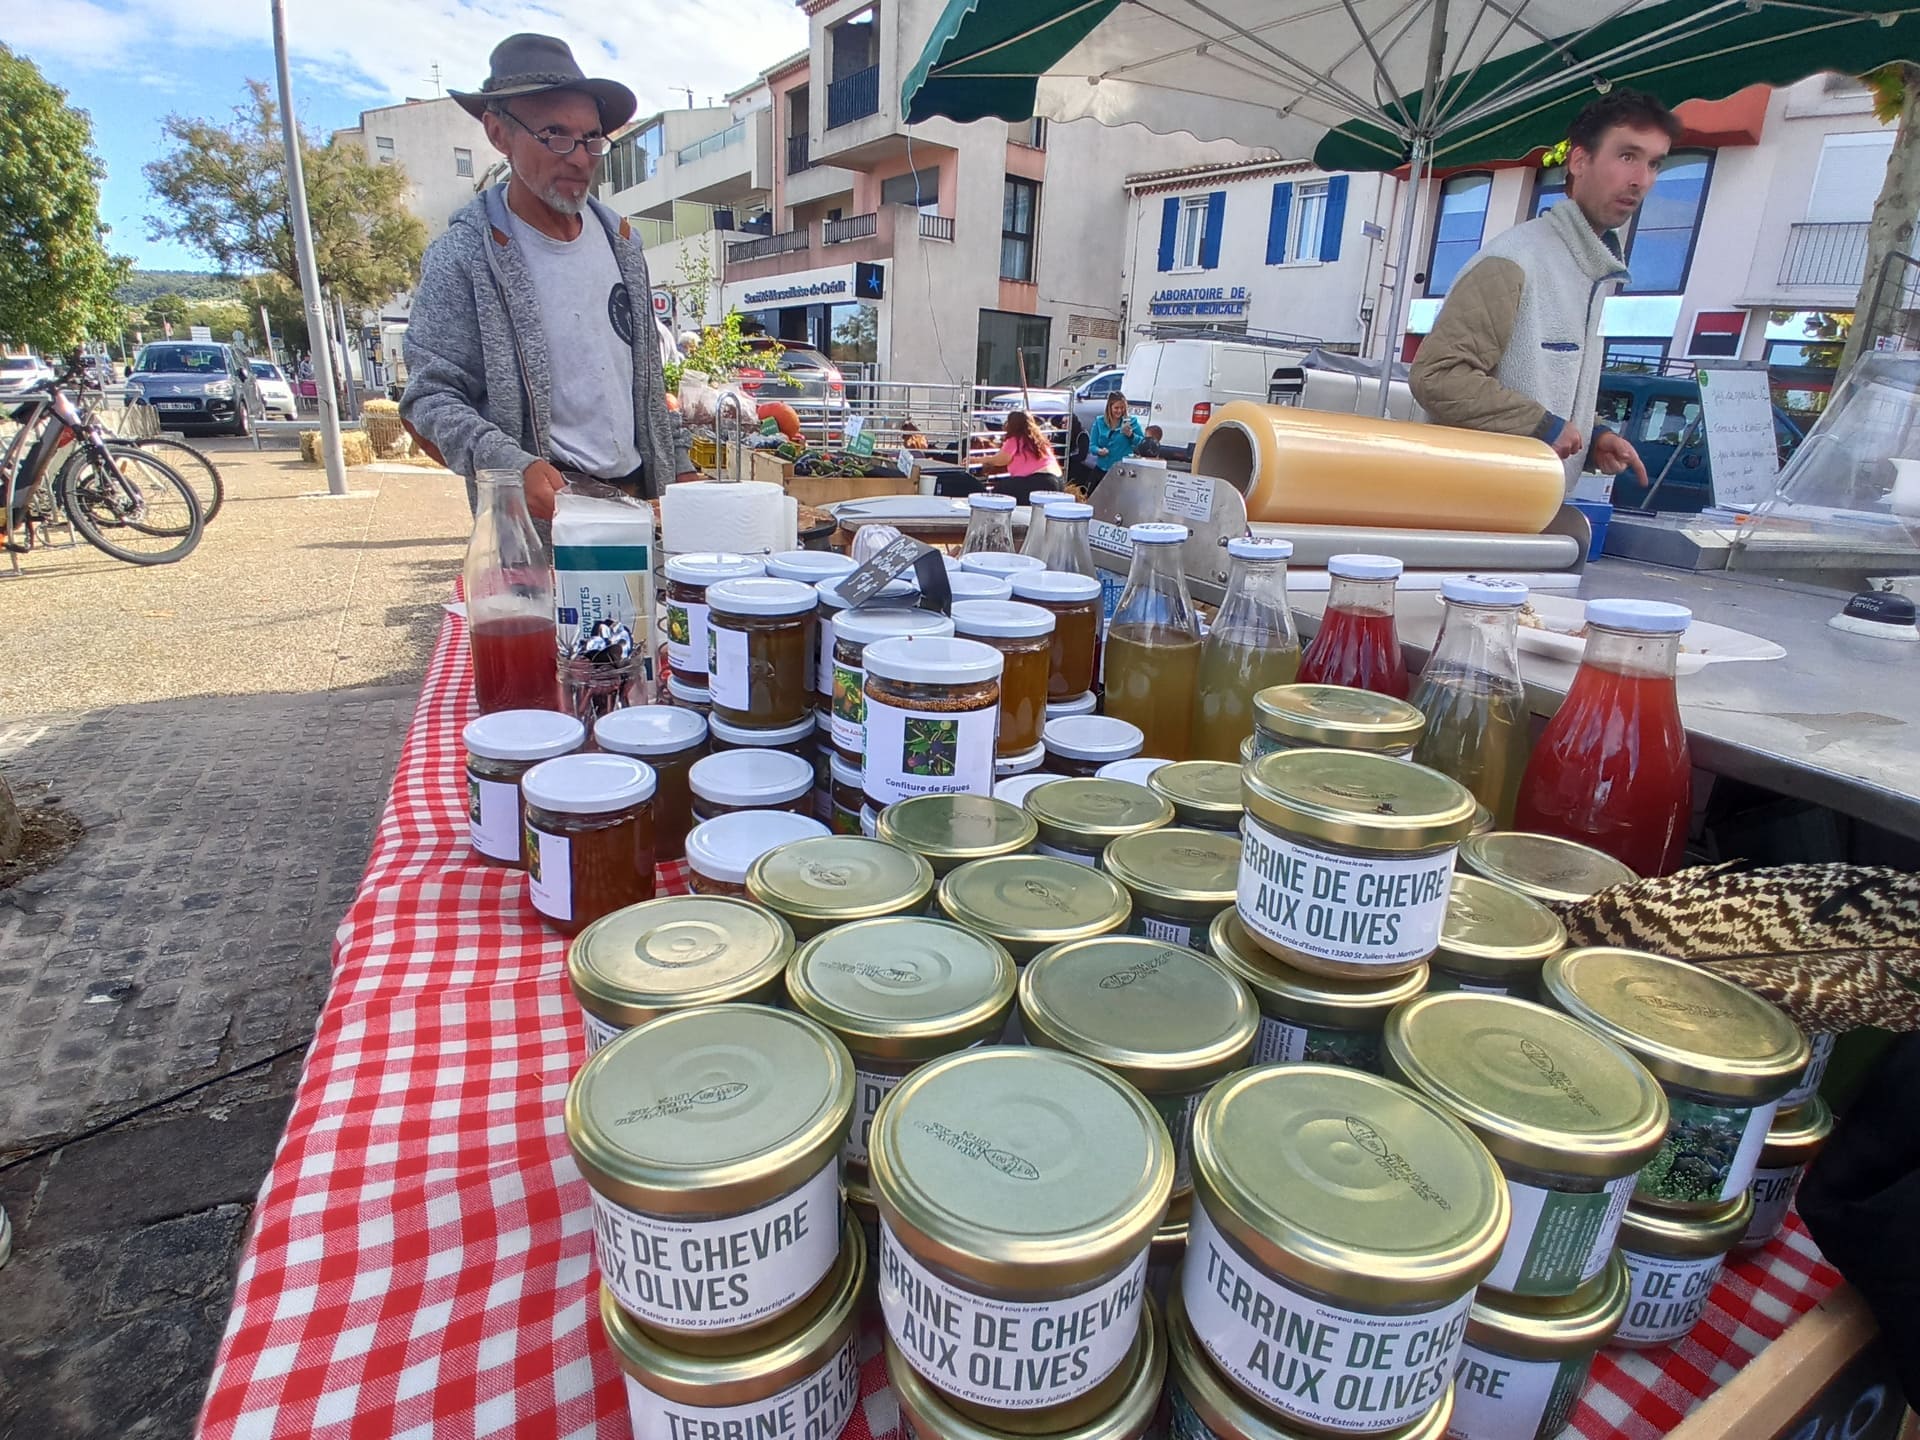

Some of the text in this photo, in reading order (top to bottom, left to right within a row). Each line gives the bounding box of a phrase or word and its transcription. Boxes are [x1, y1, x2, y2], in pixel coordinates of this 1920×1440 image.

[654, 297, 666, 310] U
[1152, 302, 1242, 316] BIOLOGIE MEDICALE
[1154, 287, 1245, 301] LABORATOIRE DE
[1098, 525, 1128, 543] CF 450
[580, 587, 592, 639] ERVIETTES
[592, 597, 602, 619] LAID
[885, 778, 970, 794] Confiture de Figues
[1243, 832, 1447, 908] ERRINE DE CHEVRE
[1255, 883, 1401, 946] AUX OLIVES
[1331, 949, 1353, 958] 13500
[631, 1228, 672, 1272] DE
[680, 1200, 809, 1274] CHEVRE
[598, 1235, 749, 1312] UX OLIVES
[882, 1230, 1142, 1353] ERRINE DE CHEVRE
[1641, 1271, 1682, 1299] DE
[670, 1317, 696, 1326] 13500
[709, 1316, 735, 1326] Julien
[1205, 1240, 1340, 1364] TERRINE
[1345, 1332, 1400, 1371] DE
[902, 1309, 1090, 1392] AUX OLIVES
[940, 1380, 961, 1392] croix
[962, 1390, 1001, 1404] d'Estrine
[1246, 1338, 1448, 1413] AUX OLIVES
[1453, 1358, 1510, 1399] VRE
[664, 1400, 796, 1440] TERRINE
[804, 1368, 834, 1419] DE
[804, 1363, 857, 1440] OLIVE
[1272, 1397, 1284, 1406] de
[1286, 1402, 1295, 1411] la
[1297, 1408, 1322, 1421] croix
[1322, 1416, 1365, 1428] d'Estrine
[1367, 1417, 1395, 1428] 13500
